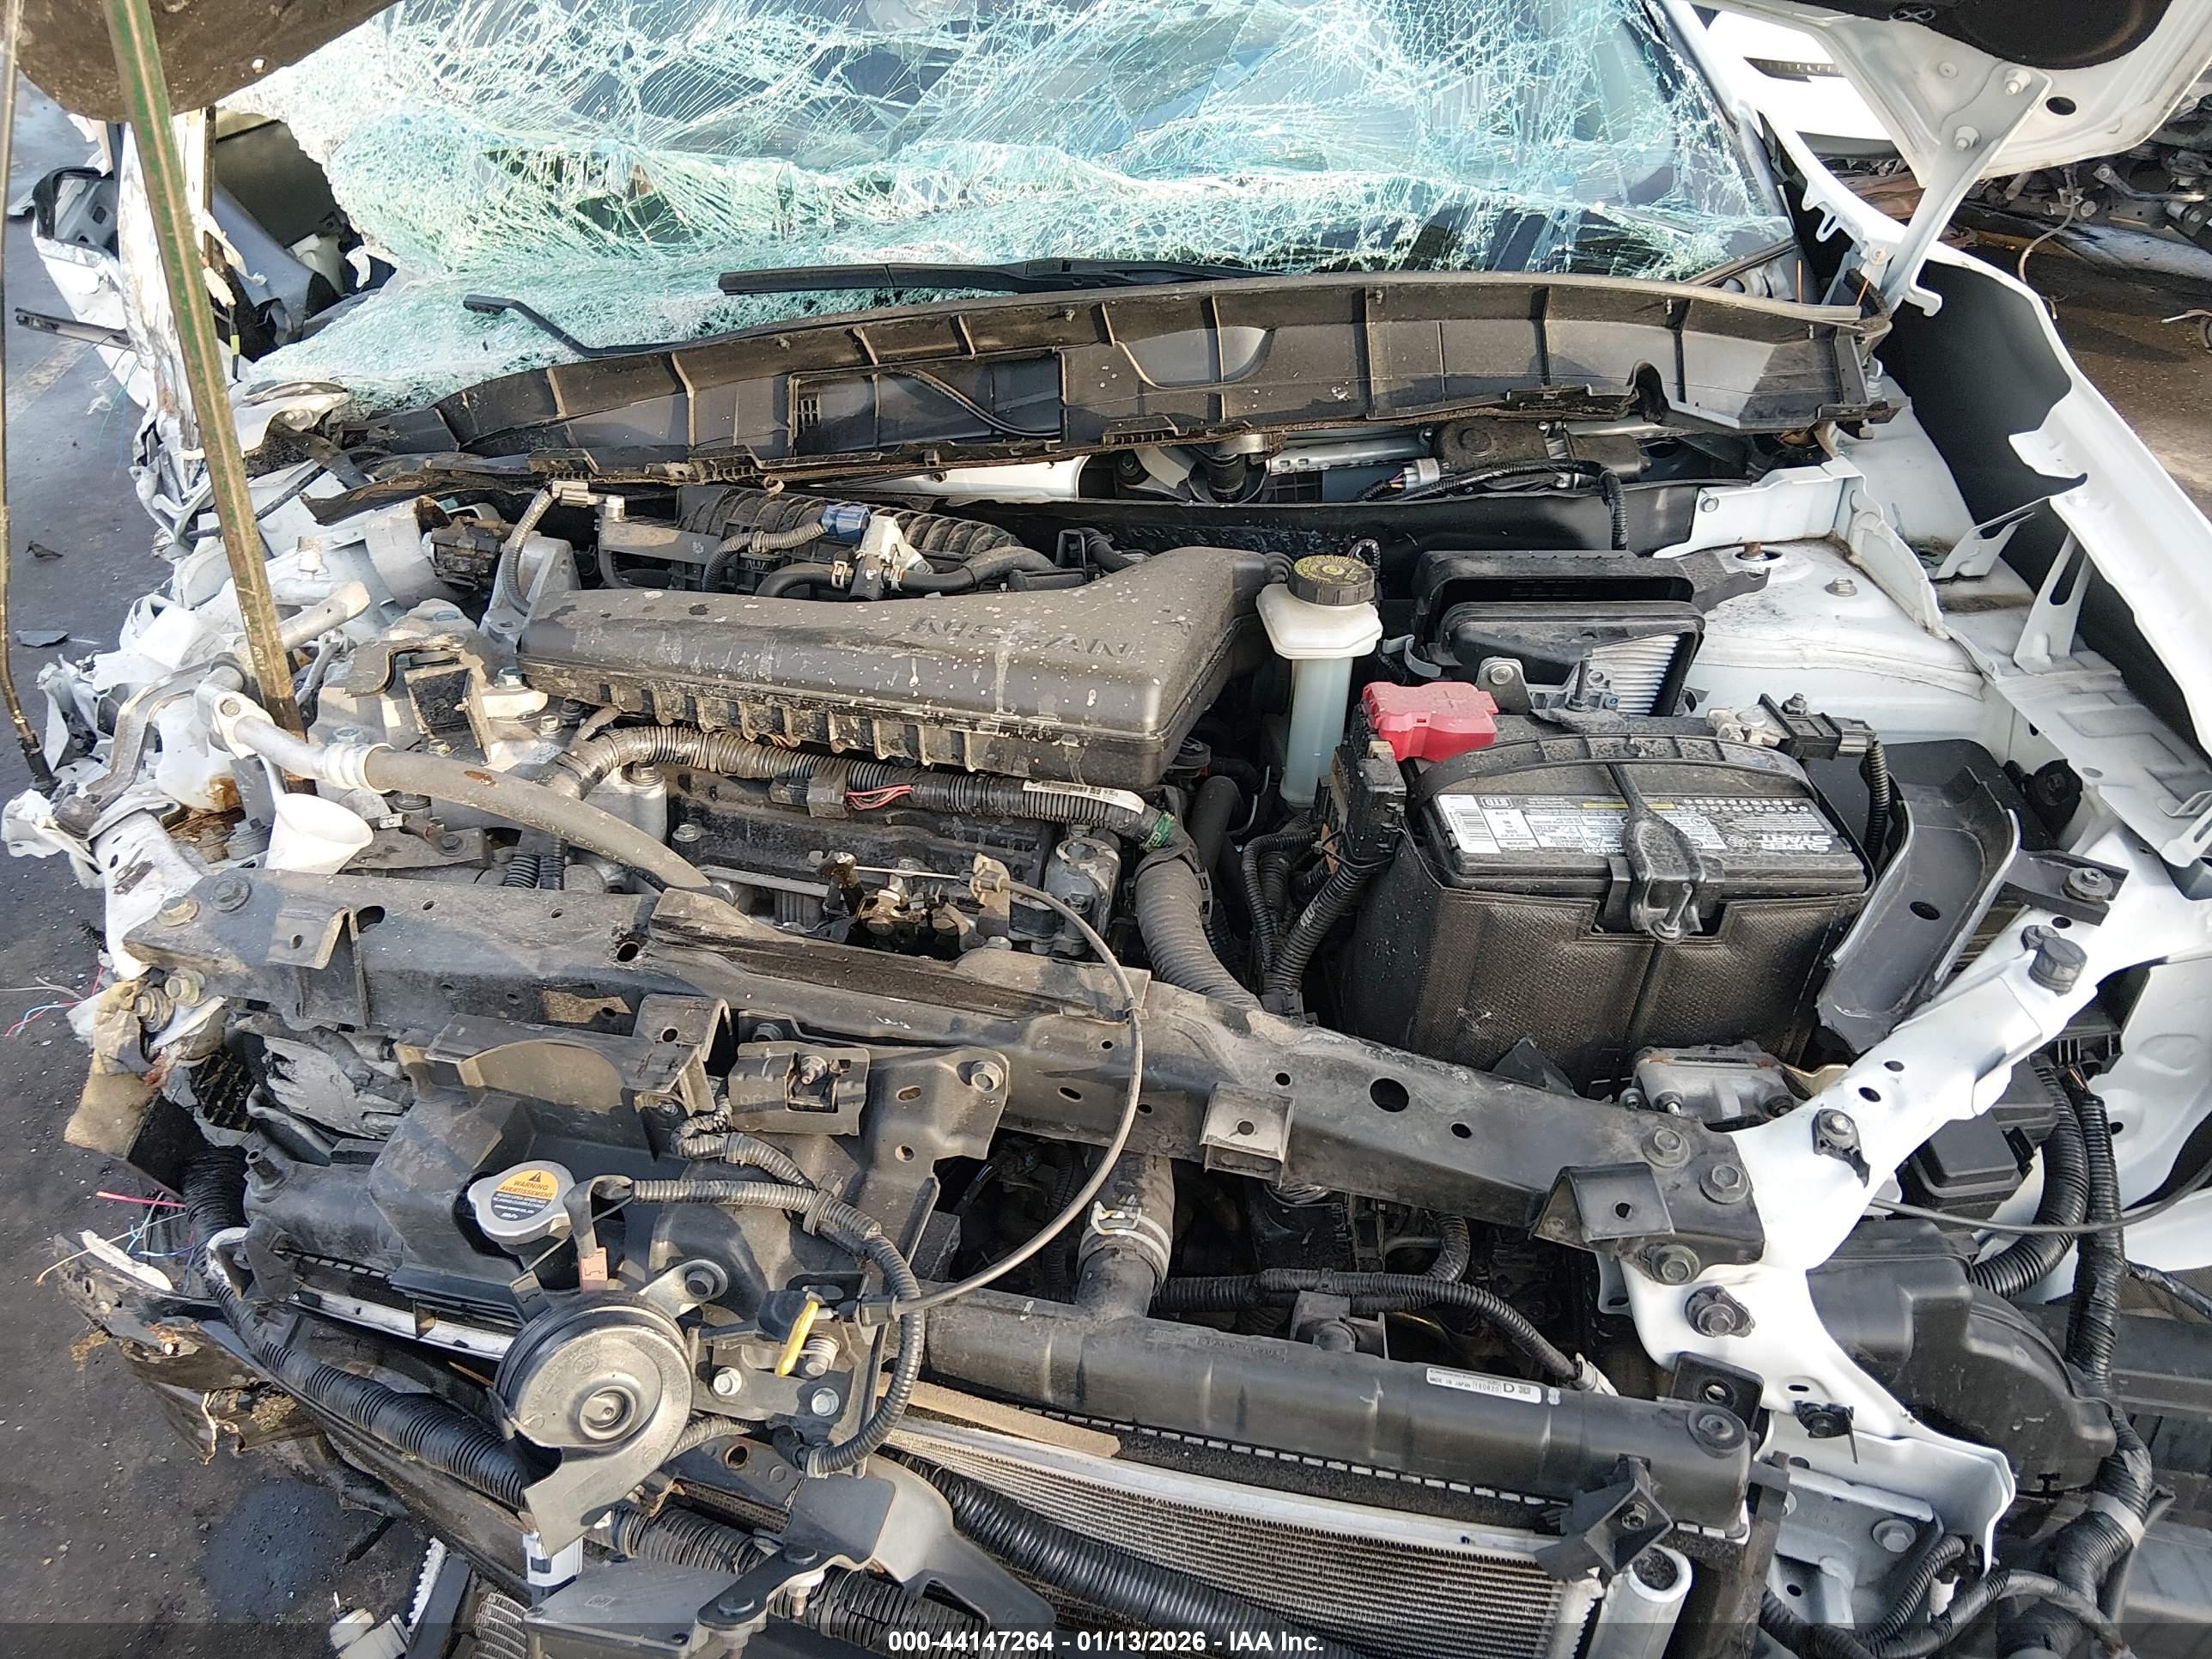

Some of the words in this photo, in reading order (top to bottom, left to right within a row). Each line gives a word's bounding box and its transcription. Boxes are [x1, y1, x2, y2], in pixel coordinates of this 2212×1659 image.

[910, 616, 1137, 659] NISSAN
[1757, 835, 1832, 845] START
[1762, 843, 1829, 852] SUPER
[514, 1181, 550, 1191] WARNING
[500, 1186, 554, 1198] AVERTISSEMENT
[1504, 1382, 1515, 1393] D
